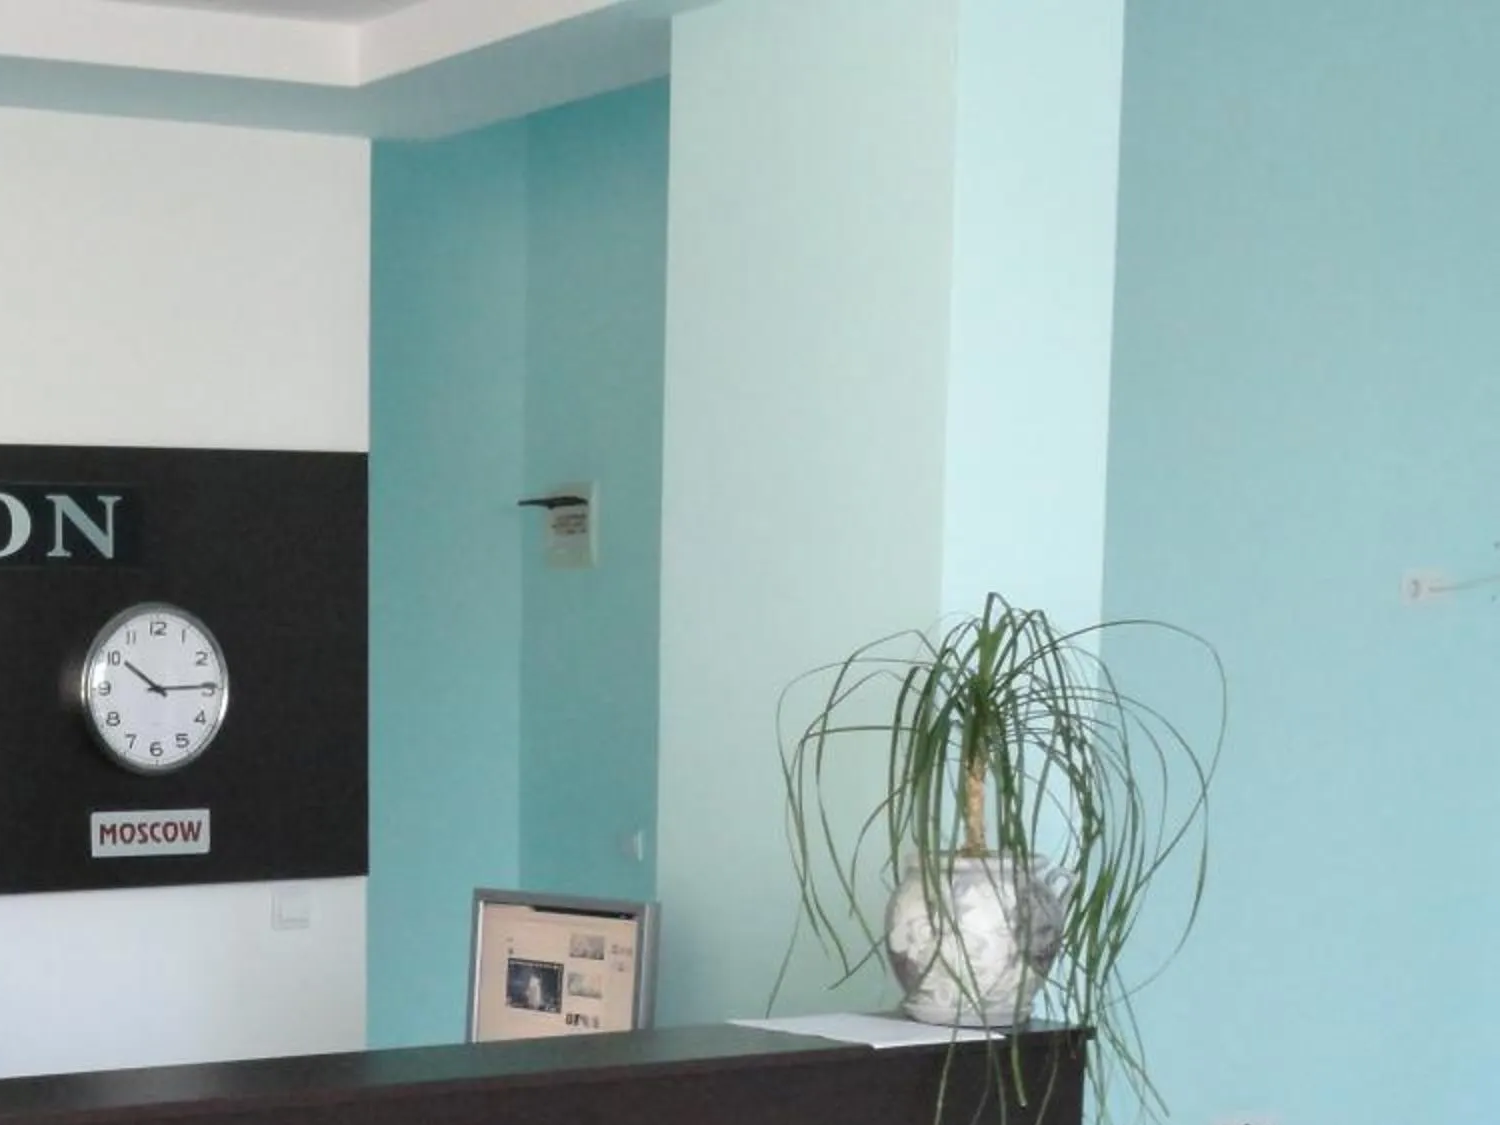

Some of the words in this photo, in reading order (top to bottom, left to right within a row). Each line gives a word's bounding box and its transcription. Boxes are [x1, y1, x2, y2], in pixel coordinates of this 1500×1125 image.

[149, 621, 168, 637] 12
[181, 628, 187, 645] 1
[126, 630, 137, 645] 11
[106, 650, 121, 666] 10
[195, 651, 209, 666] 2
[98, 680, 112, 697] 9
[106, 711, 121, 727] 8
[193, 709, 207, 725] 4
[126, 733, 137, 750] 7
[150, 741, 164, 757] 6
[175, 733, 190, 749] 5
[100, 820, 202, 845] MOSCOW
